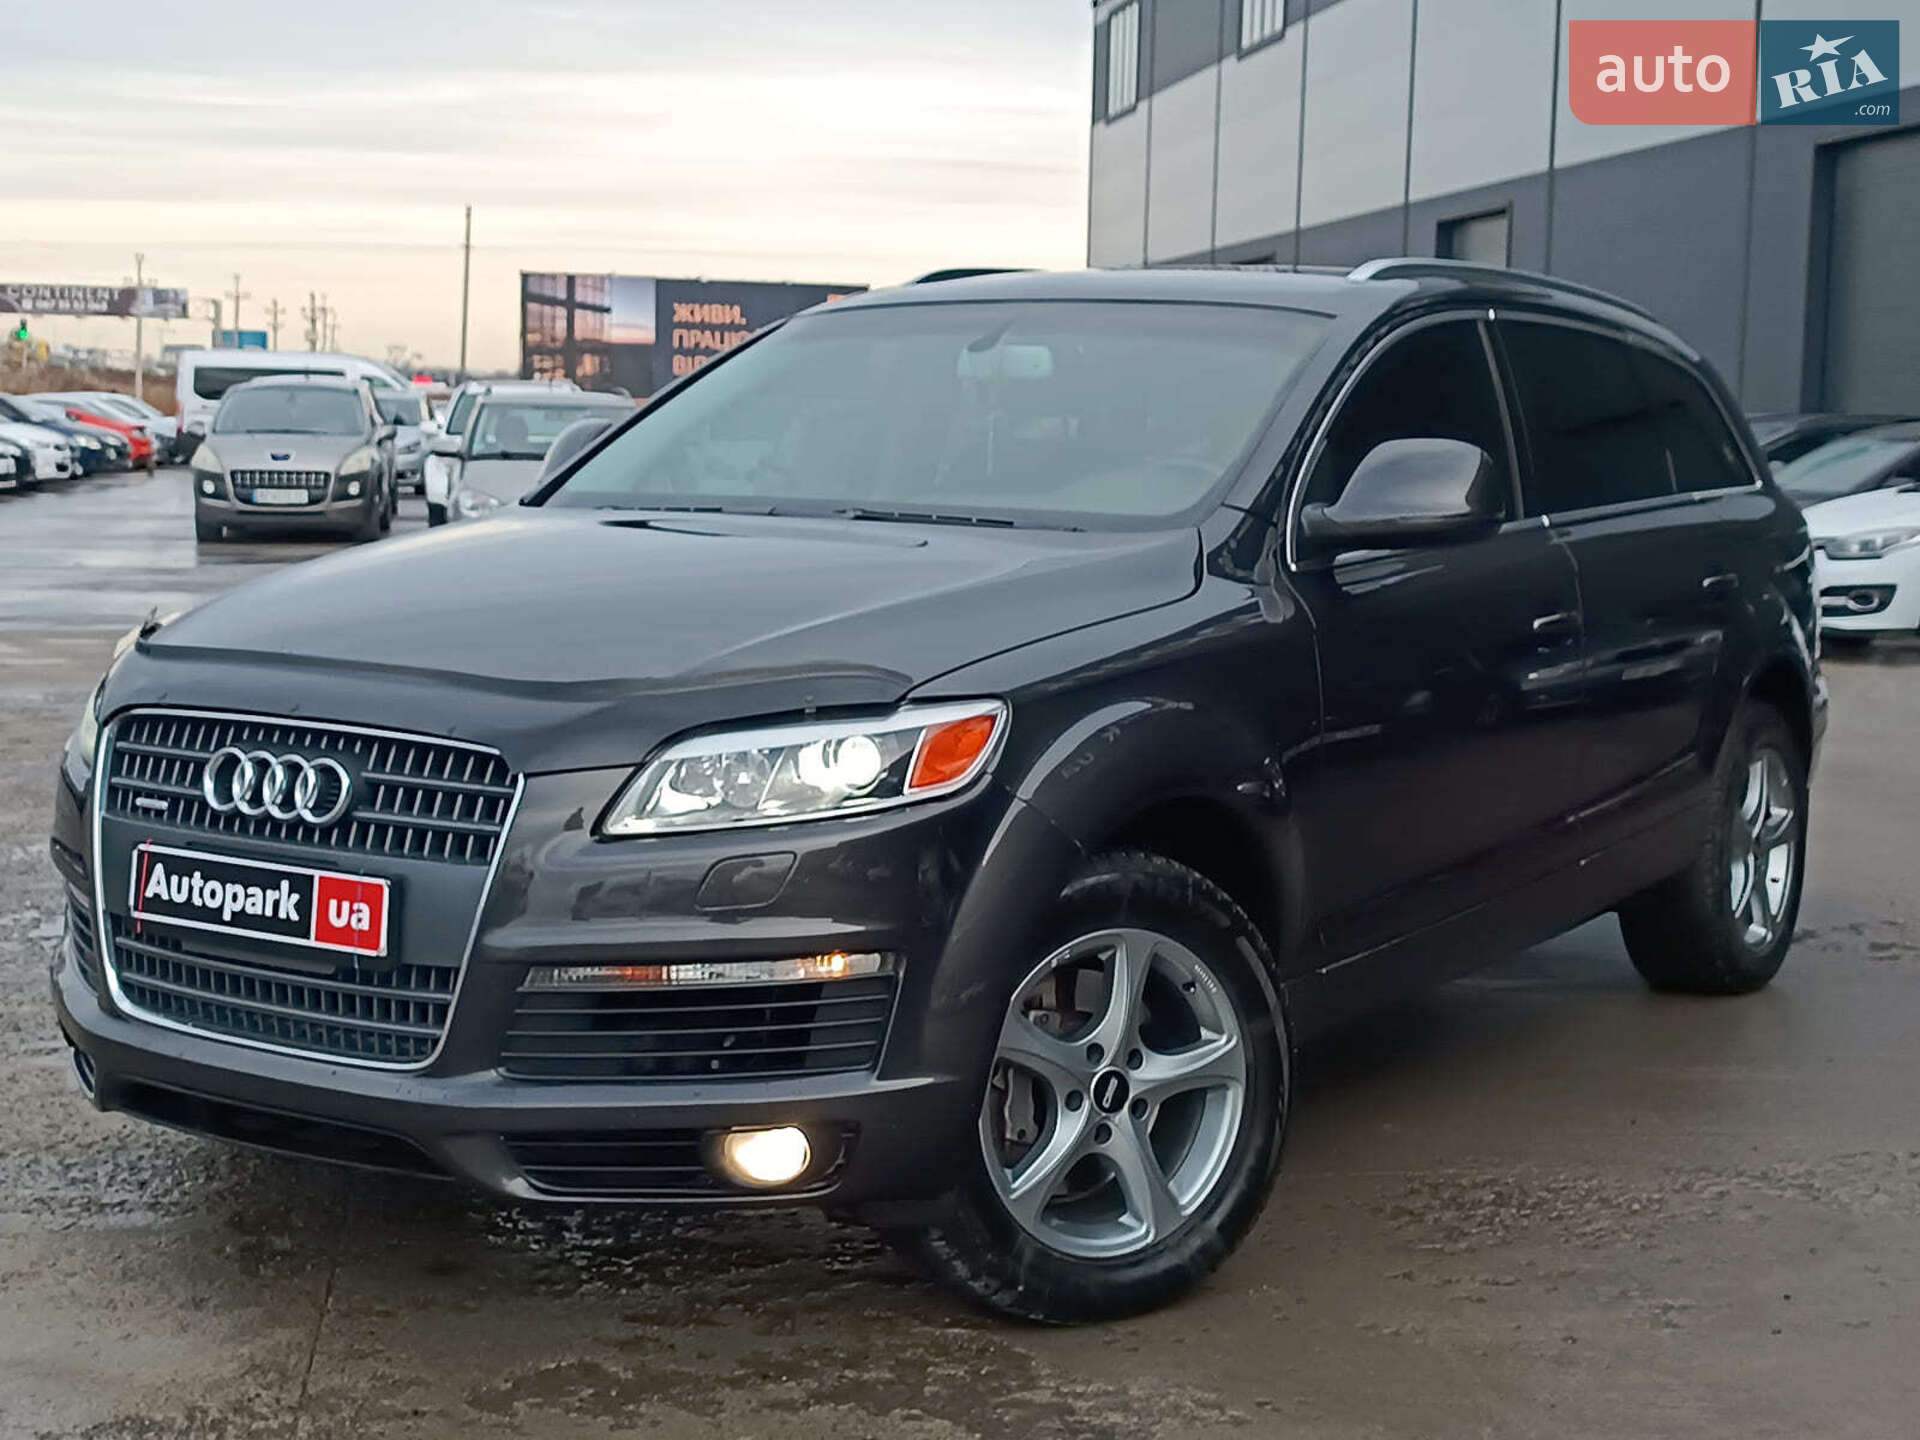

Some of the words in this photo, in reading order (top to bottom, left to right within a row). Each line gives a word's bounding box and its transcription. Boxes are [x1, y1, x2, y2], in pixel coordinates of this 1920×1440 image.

[7, 286, 120, 301] CONTINENT
[672, 302, 747, 325] ЖИВИ.
[672, 328, 755, 351] ПРАЦЮ
[144, 862, 301, 922] Autopark
[328, 898, 371, 931] ua
